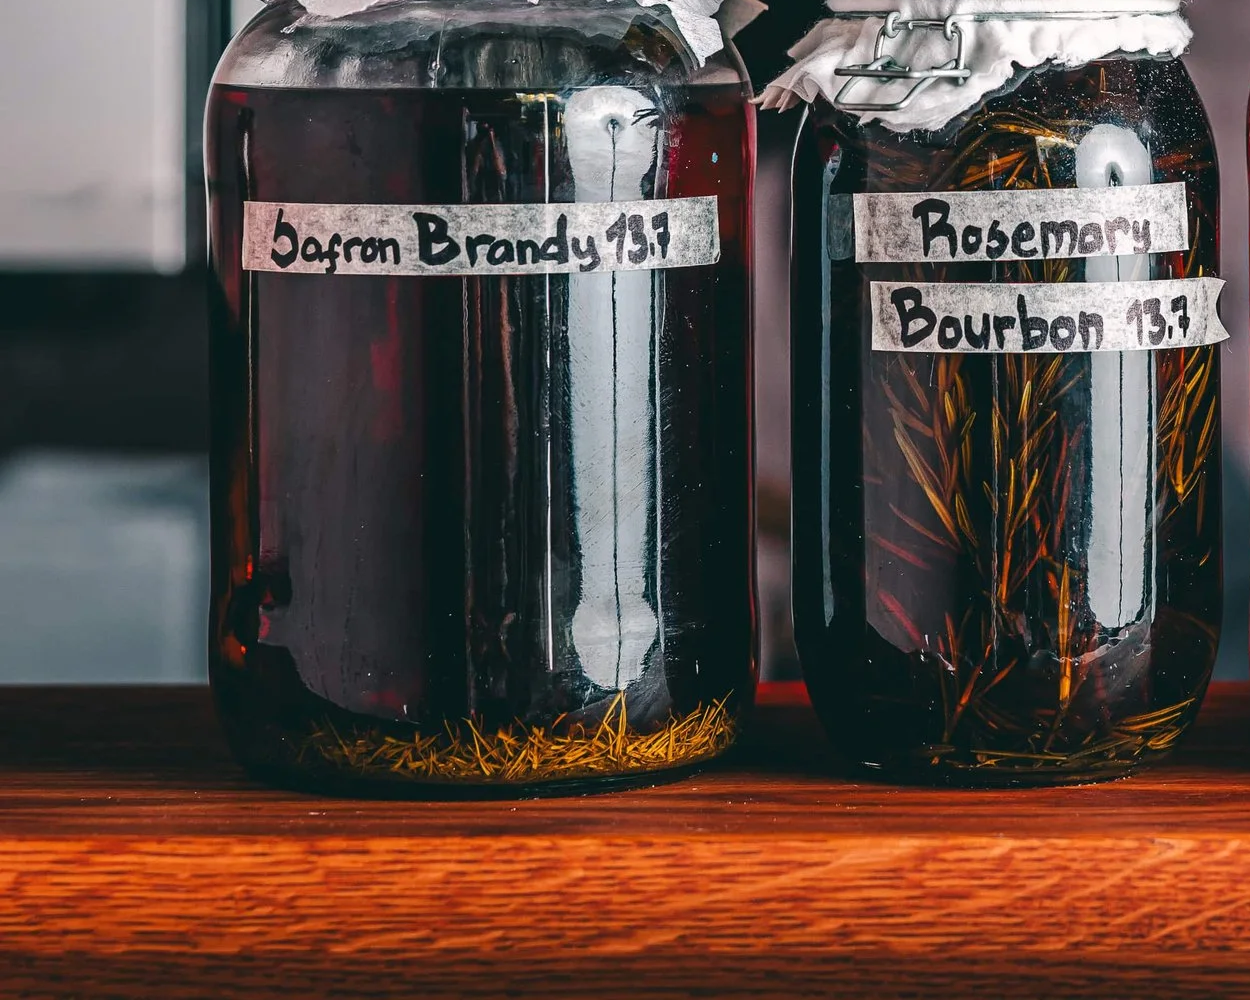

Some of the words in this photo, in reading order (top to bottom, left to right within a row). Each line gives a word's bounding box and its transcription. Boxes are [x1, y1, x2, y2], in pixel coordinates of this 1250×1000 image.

[413, 211, 601, 272] Brandy
[912, 198, 1151, 259] Rosemary
[890, 286, 1105, 352] Bourbon
